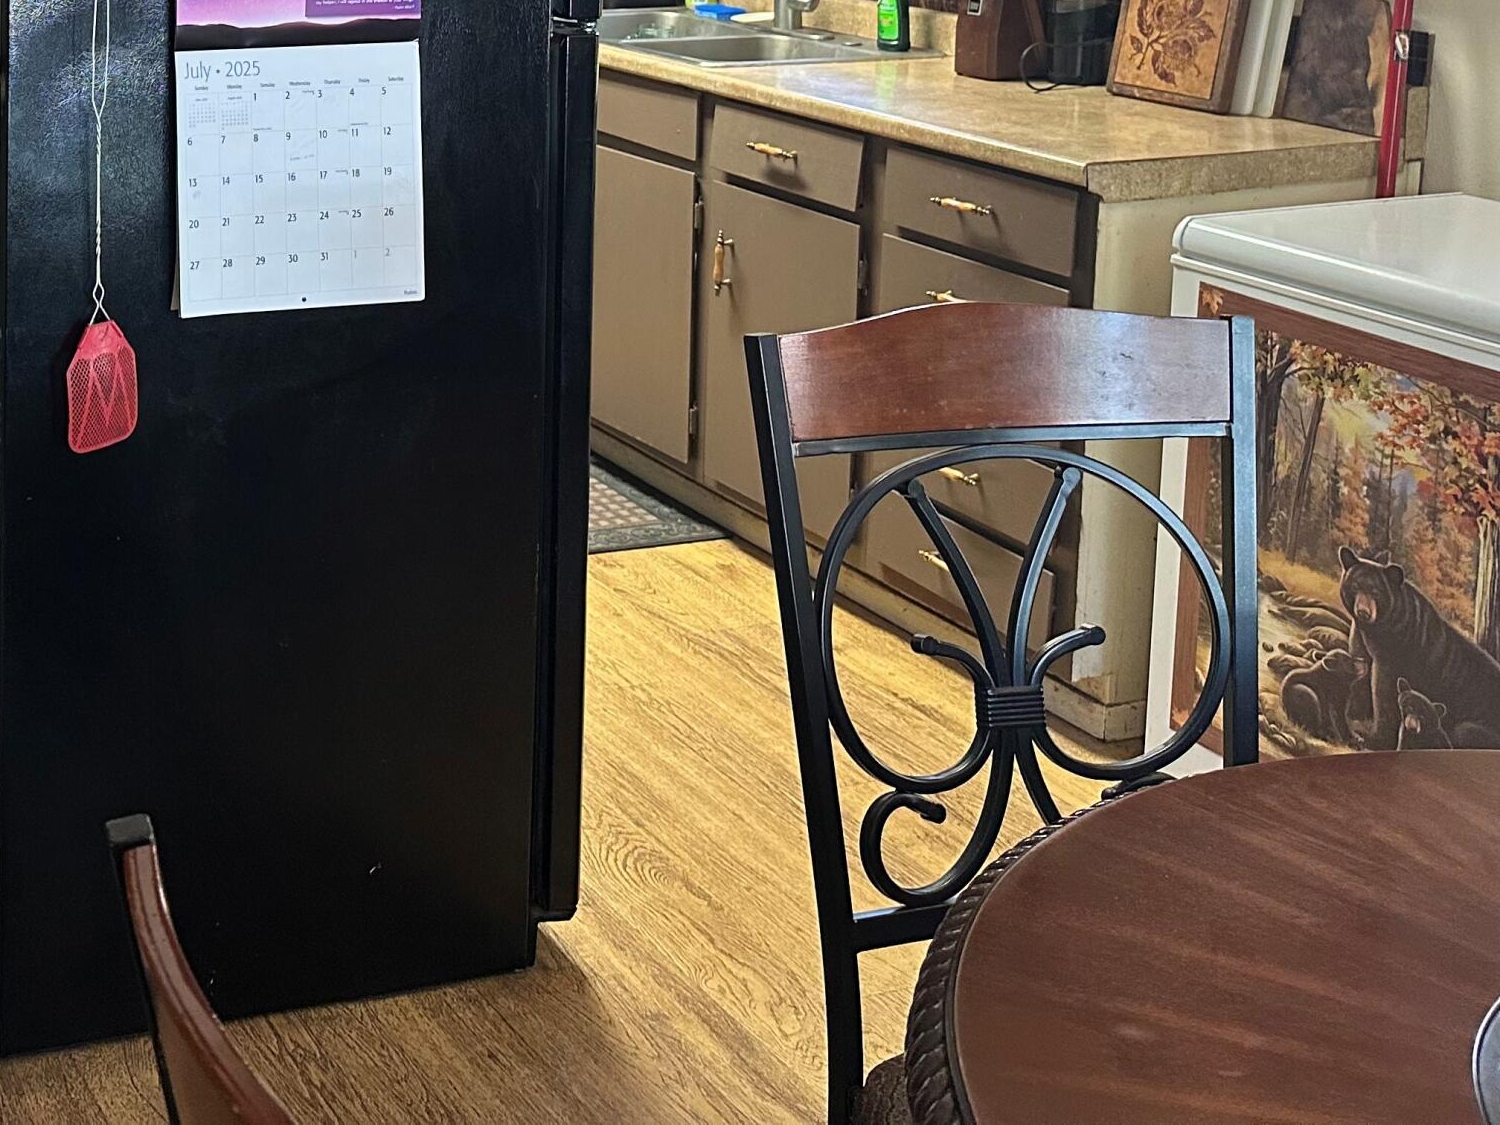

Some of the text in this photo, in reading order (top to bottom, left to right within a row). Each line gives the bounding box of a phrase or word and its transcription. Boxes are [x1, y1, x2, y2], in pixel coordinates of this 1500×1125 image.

[185, 61, 260, 82] July 2025
[253, 87, 386, 101] 1 2 3 4 5
[187, 126, 391, 146] 6 7 8 9 10 11 12
[189, 167, 392, 187] 13 14 15 16 17 18 19
[189, 207, 394, 229] 20 21 22 23 24 25 26
[190, 248, 390, 270] 27 28 29 30 31 1 2
